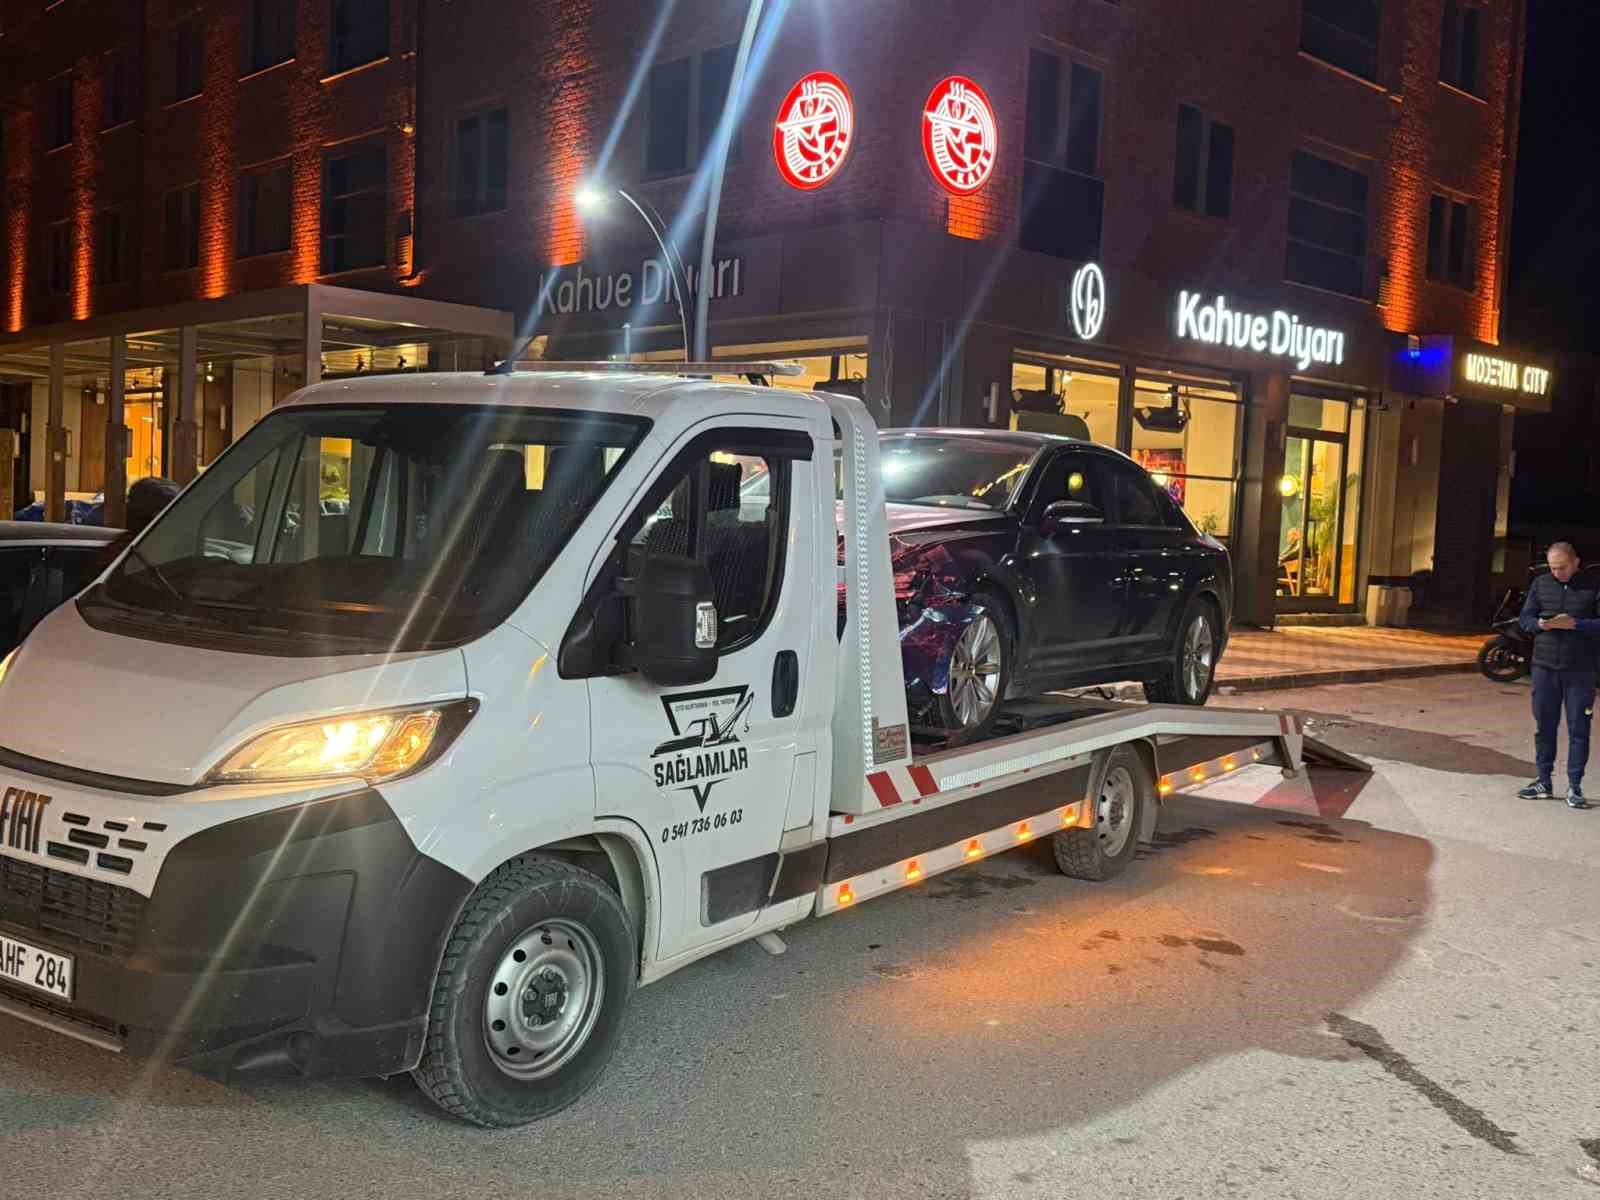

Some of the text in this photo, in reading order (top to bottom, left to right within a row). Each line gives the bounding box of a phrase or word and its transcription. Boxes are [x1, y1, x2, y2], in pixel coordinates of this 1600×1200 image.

[1522, 366, 1549, 395] CITY
[654, 747, 748, 787] SAĞLAMLAR
[0, 786, 53, 854] FIAT
[662, 808, 743, 843] 0 541 736 06 03
[35, 953, 66, 993] 284
